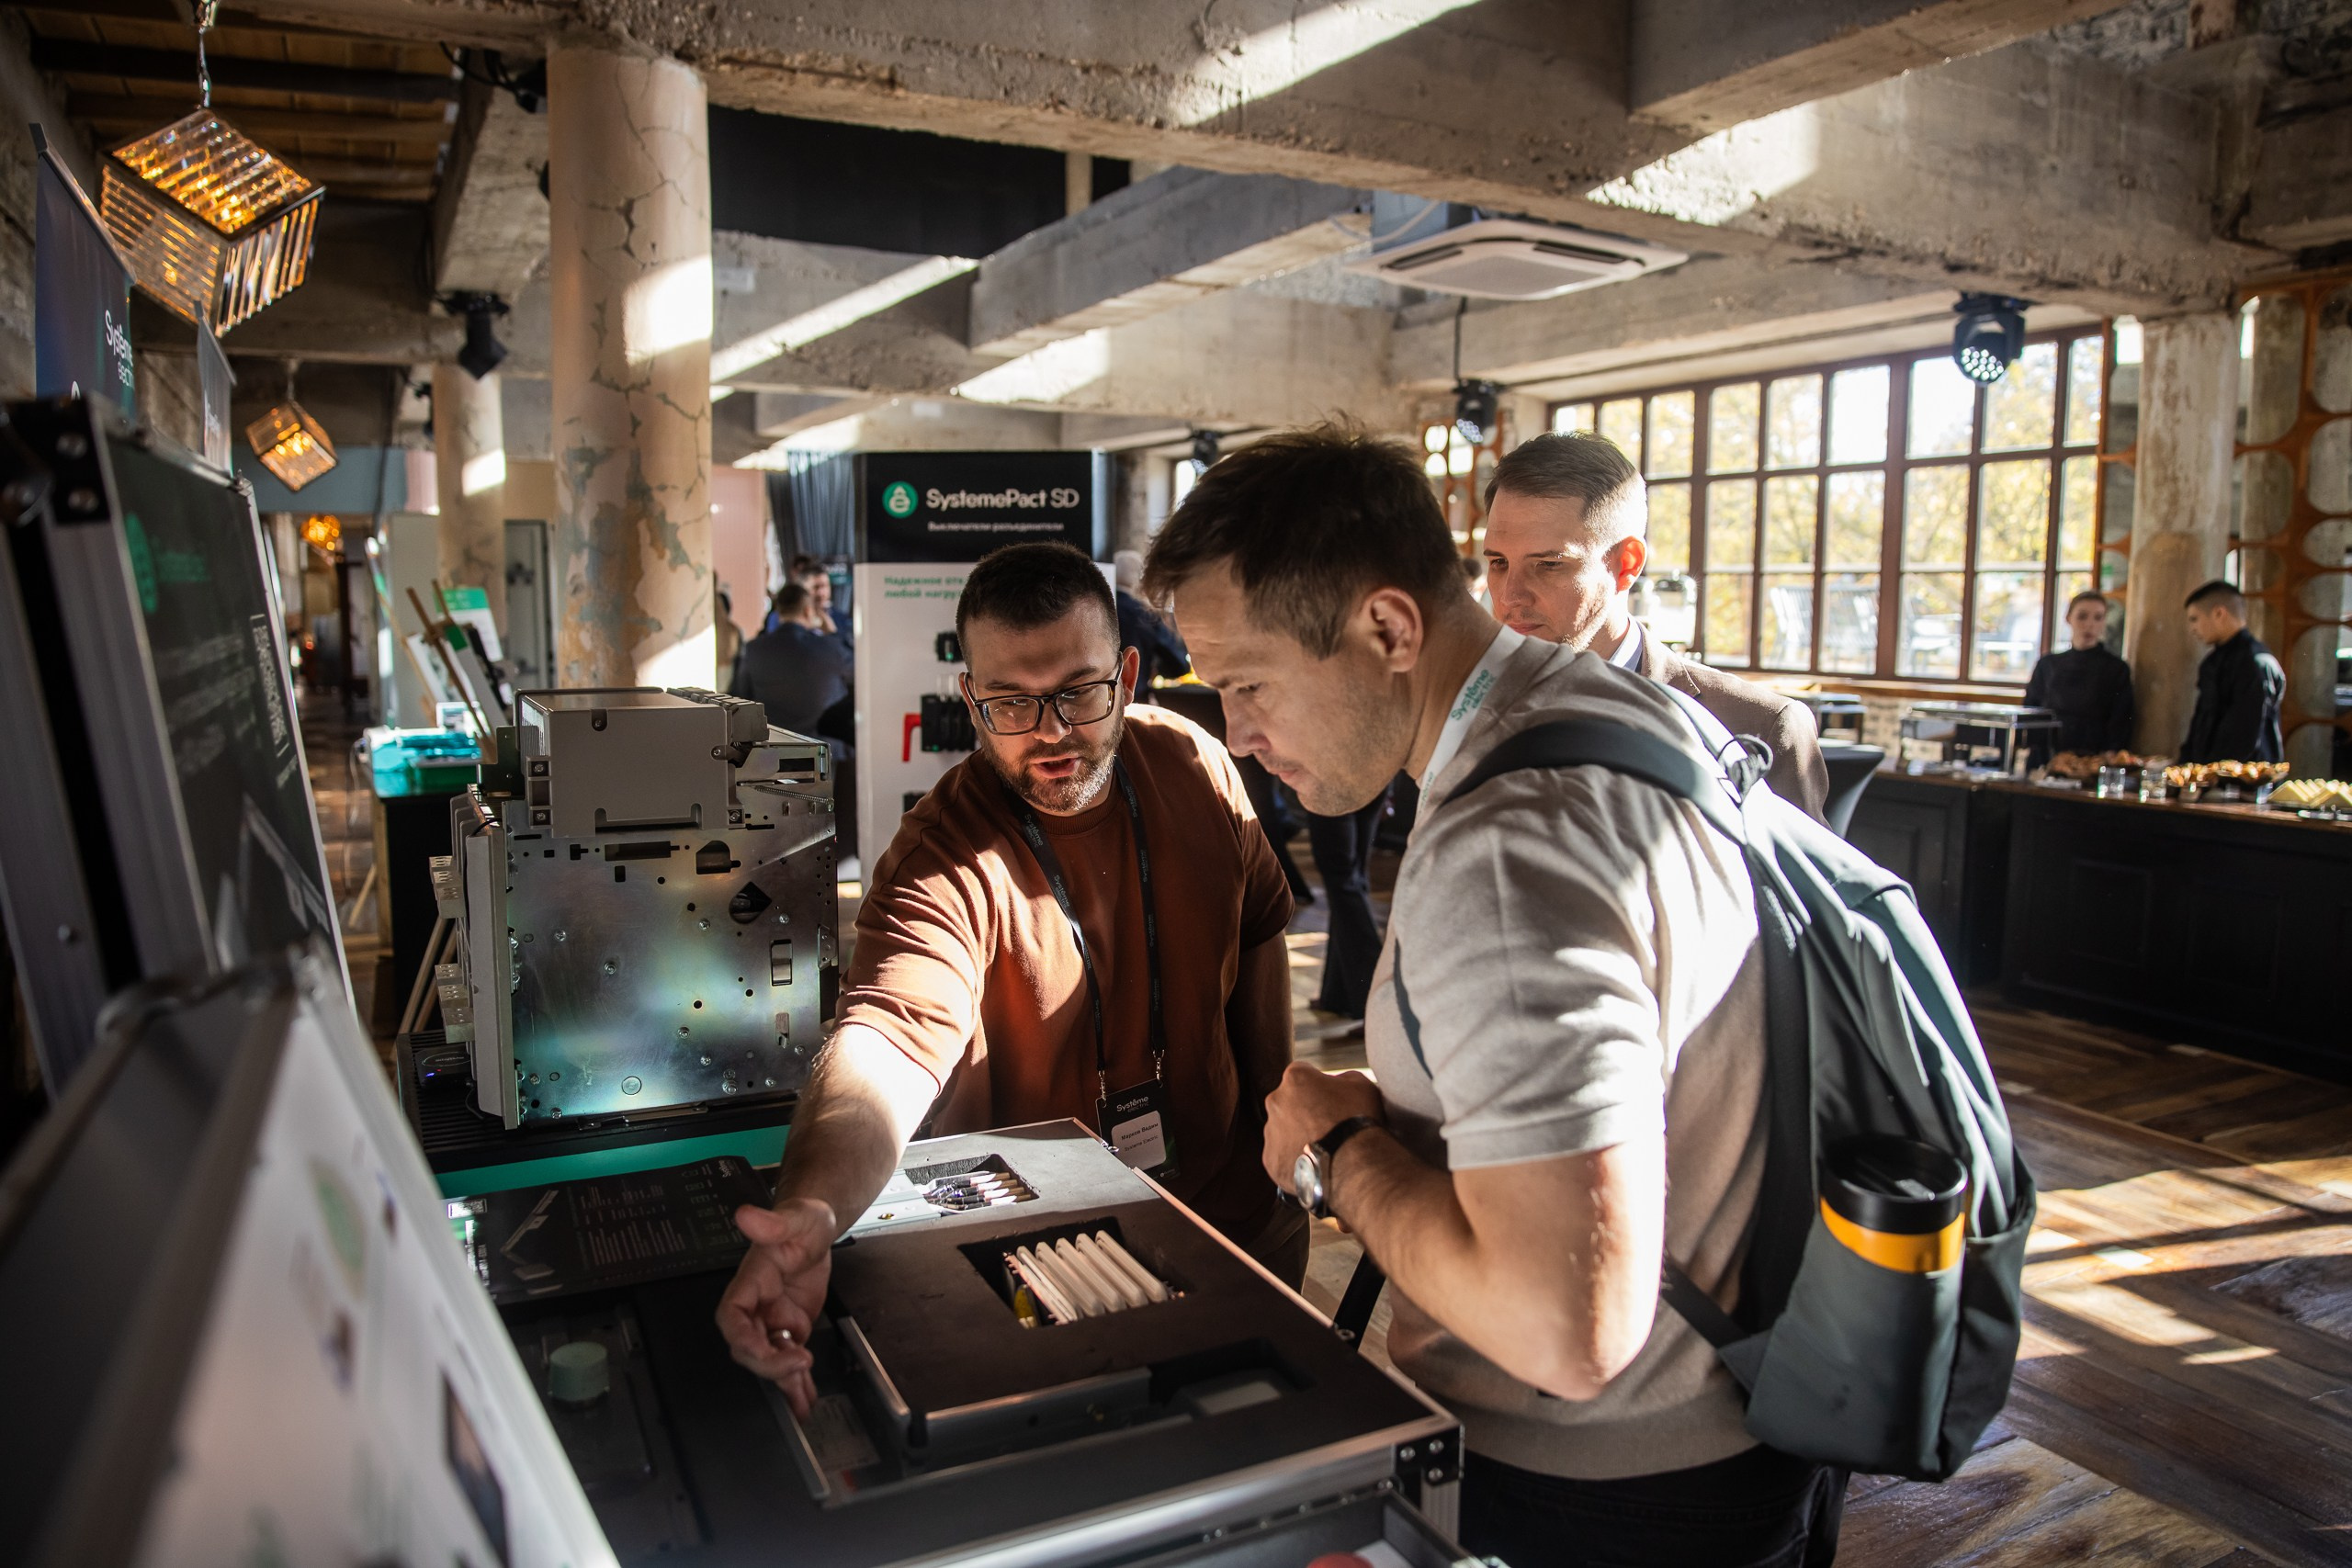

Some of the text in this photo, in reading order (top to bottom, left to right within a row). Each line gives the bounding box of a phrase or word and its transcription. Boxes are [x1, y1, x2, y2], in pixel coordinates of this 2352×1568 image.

[926, 488, 1080, 512] SystemePact SD
[1451, 669, 1489, 721] Systême
[1116, 1096, 1149, 1112] Systême
[1141, 1122, 1159, 1133] Вадим
